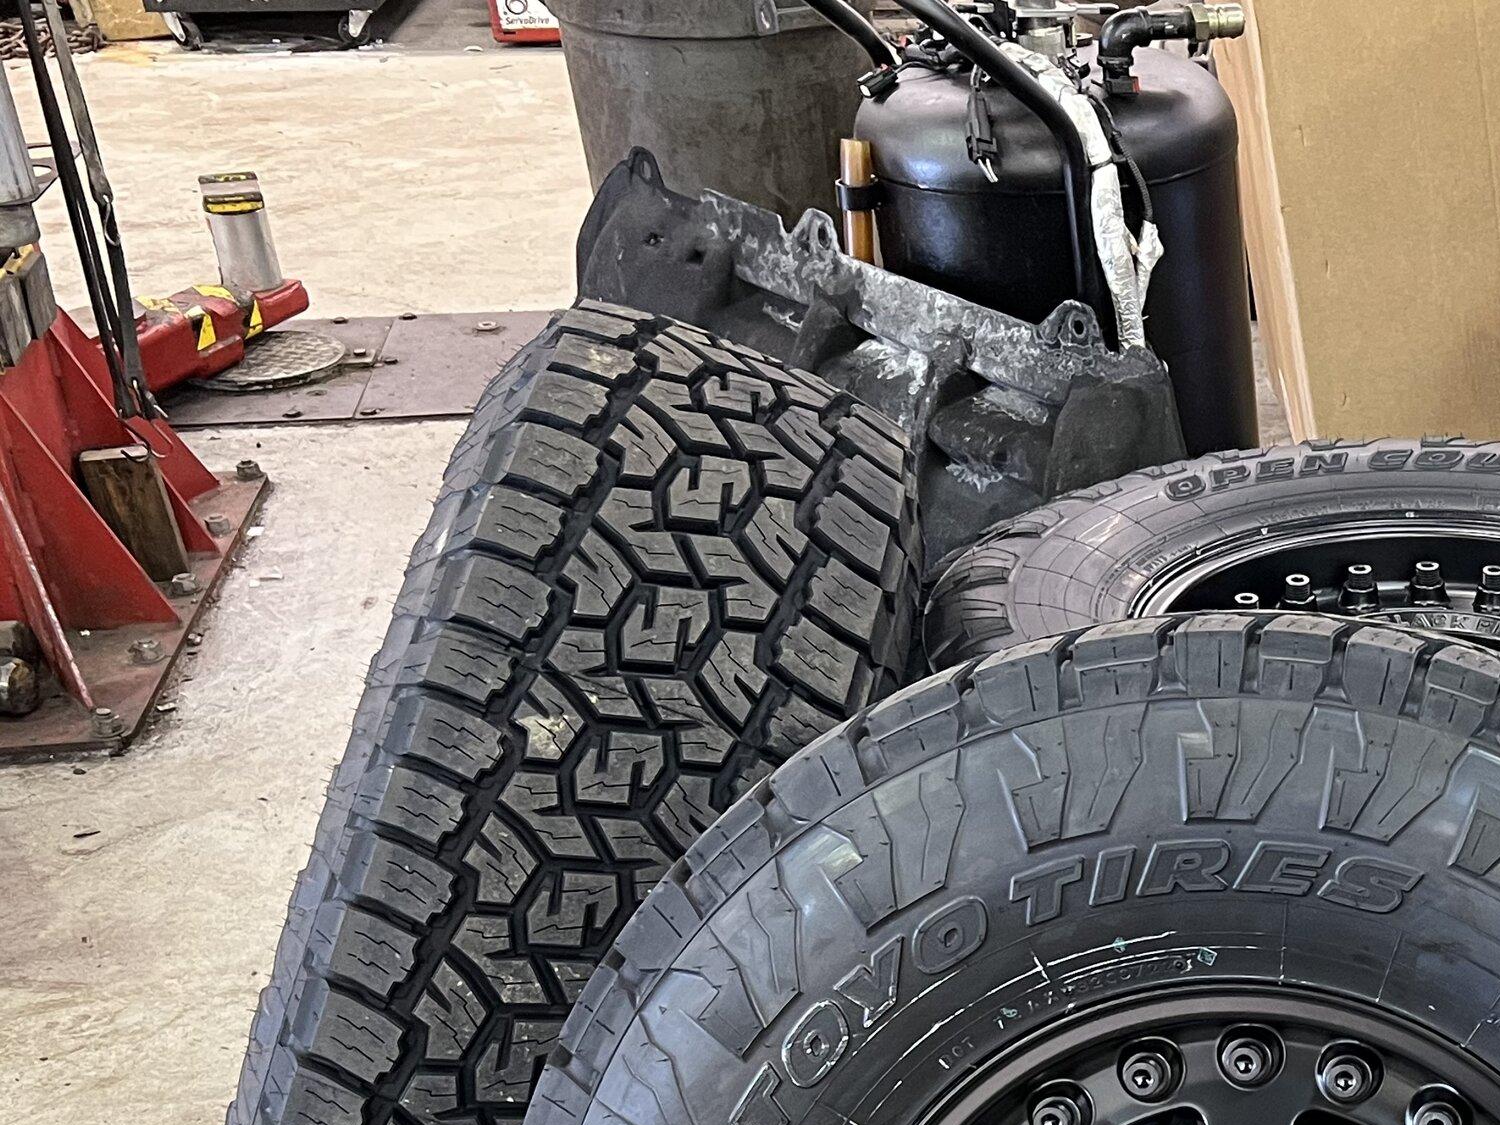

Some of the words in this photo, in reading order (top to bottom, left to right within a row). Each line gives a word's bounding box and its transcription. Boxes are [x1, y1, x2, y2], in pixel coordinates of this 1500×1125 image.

[1165, 452, 1349, 501] OPEN
[1375, 613, 1470, 629] LACK
[1009, 837, 1425, 927] TIRES
